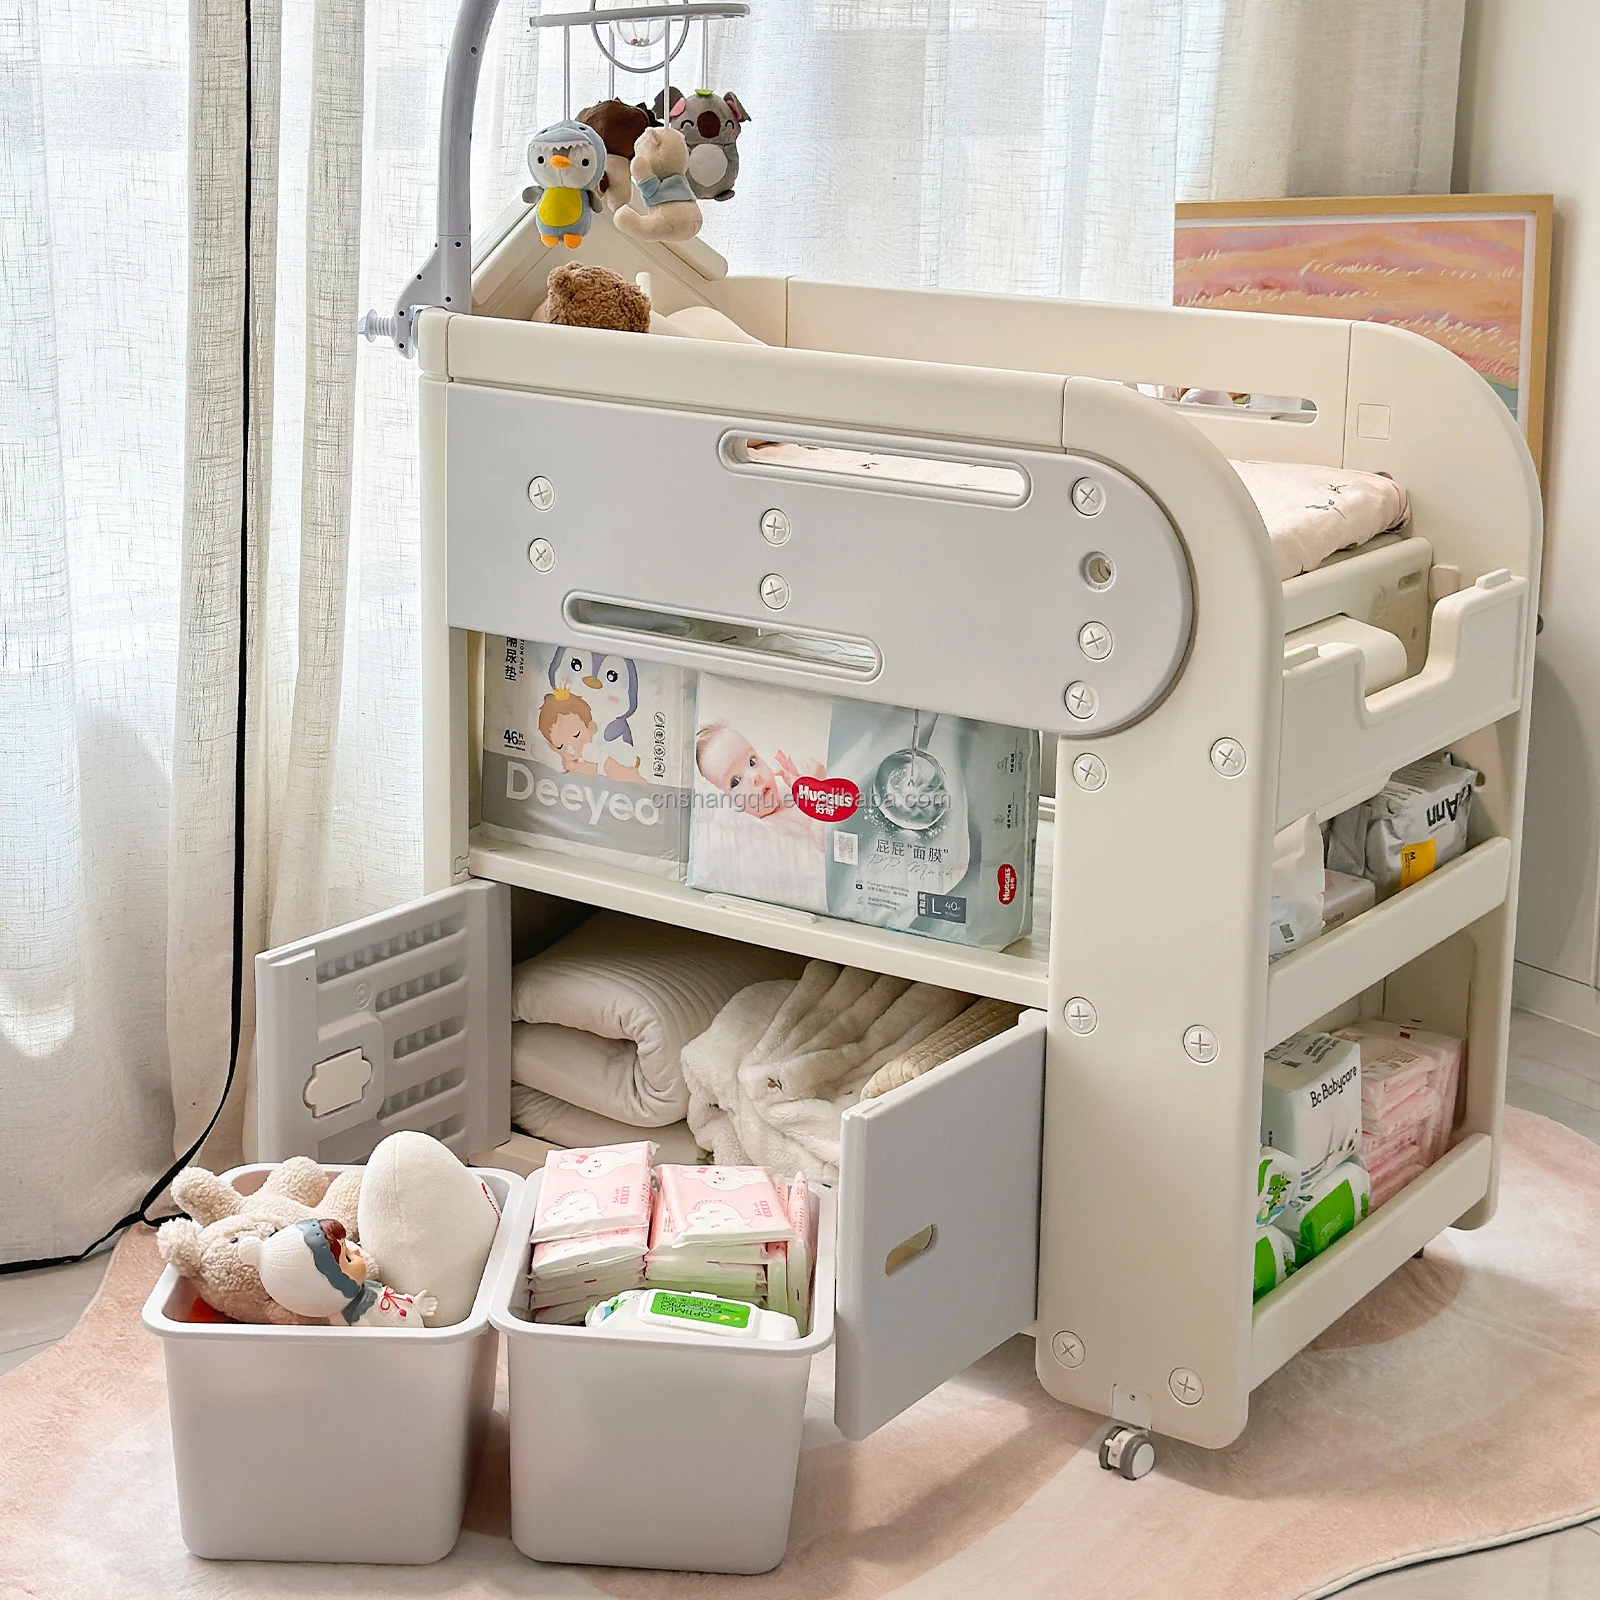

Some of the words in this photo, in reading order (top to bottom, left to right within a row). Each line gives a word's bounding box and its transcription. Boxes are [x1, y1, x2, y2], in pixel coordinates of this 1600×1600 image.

[503, 729, 519, 745] 46
[506, 760, 660, 826] Deeyeo
[931, 897, 942, 915] L
[944, 901, 958, 911] 40
